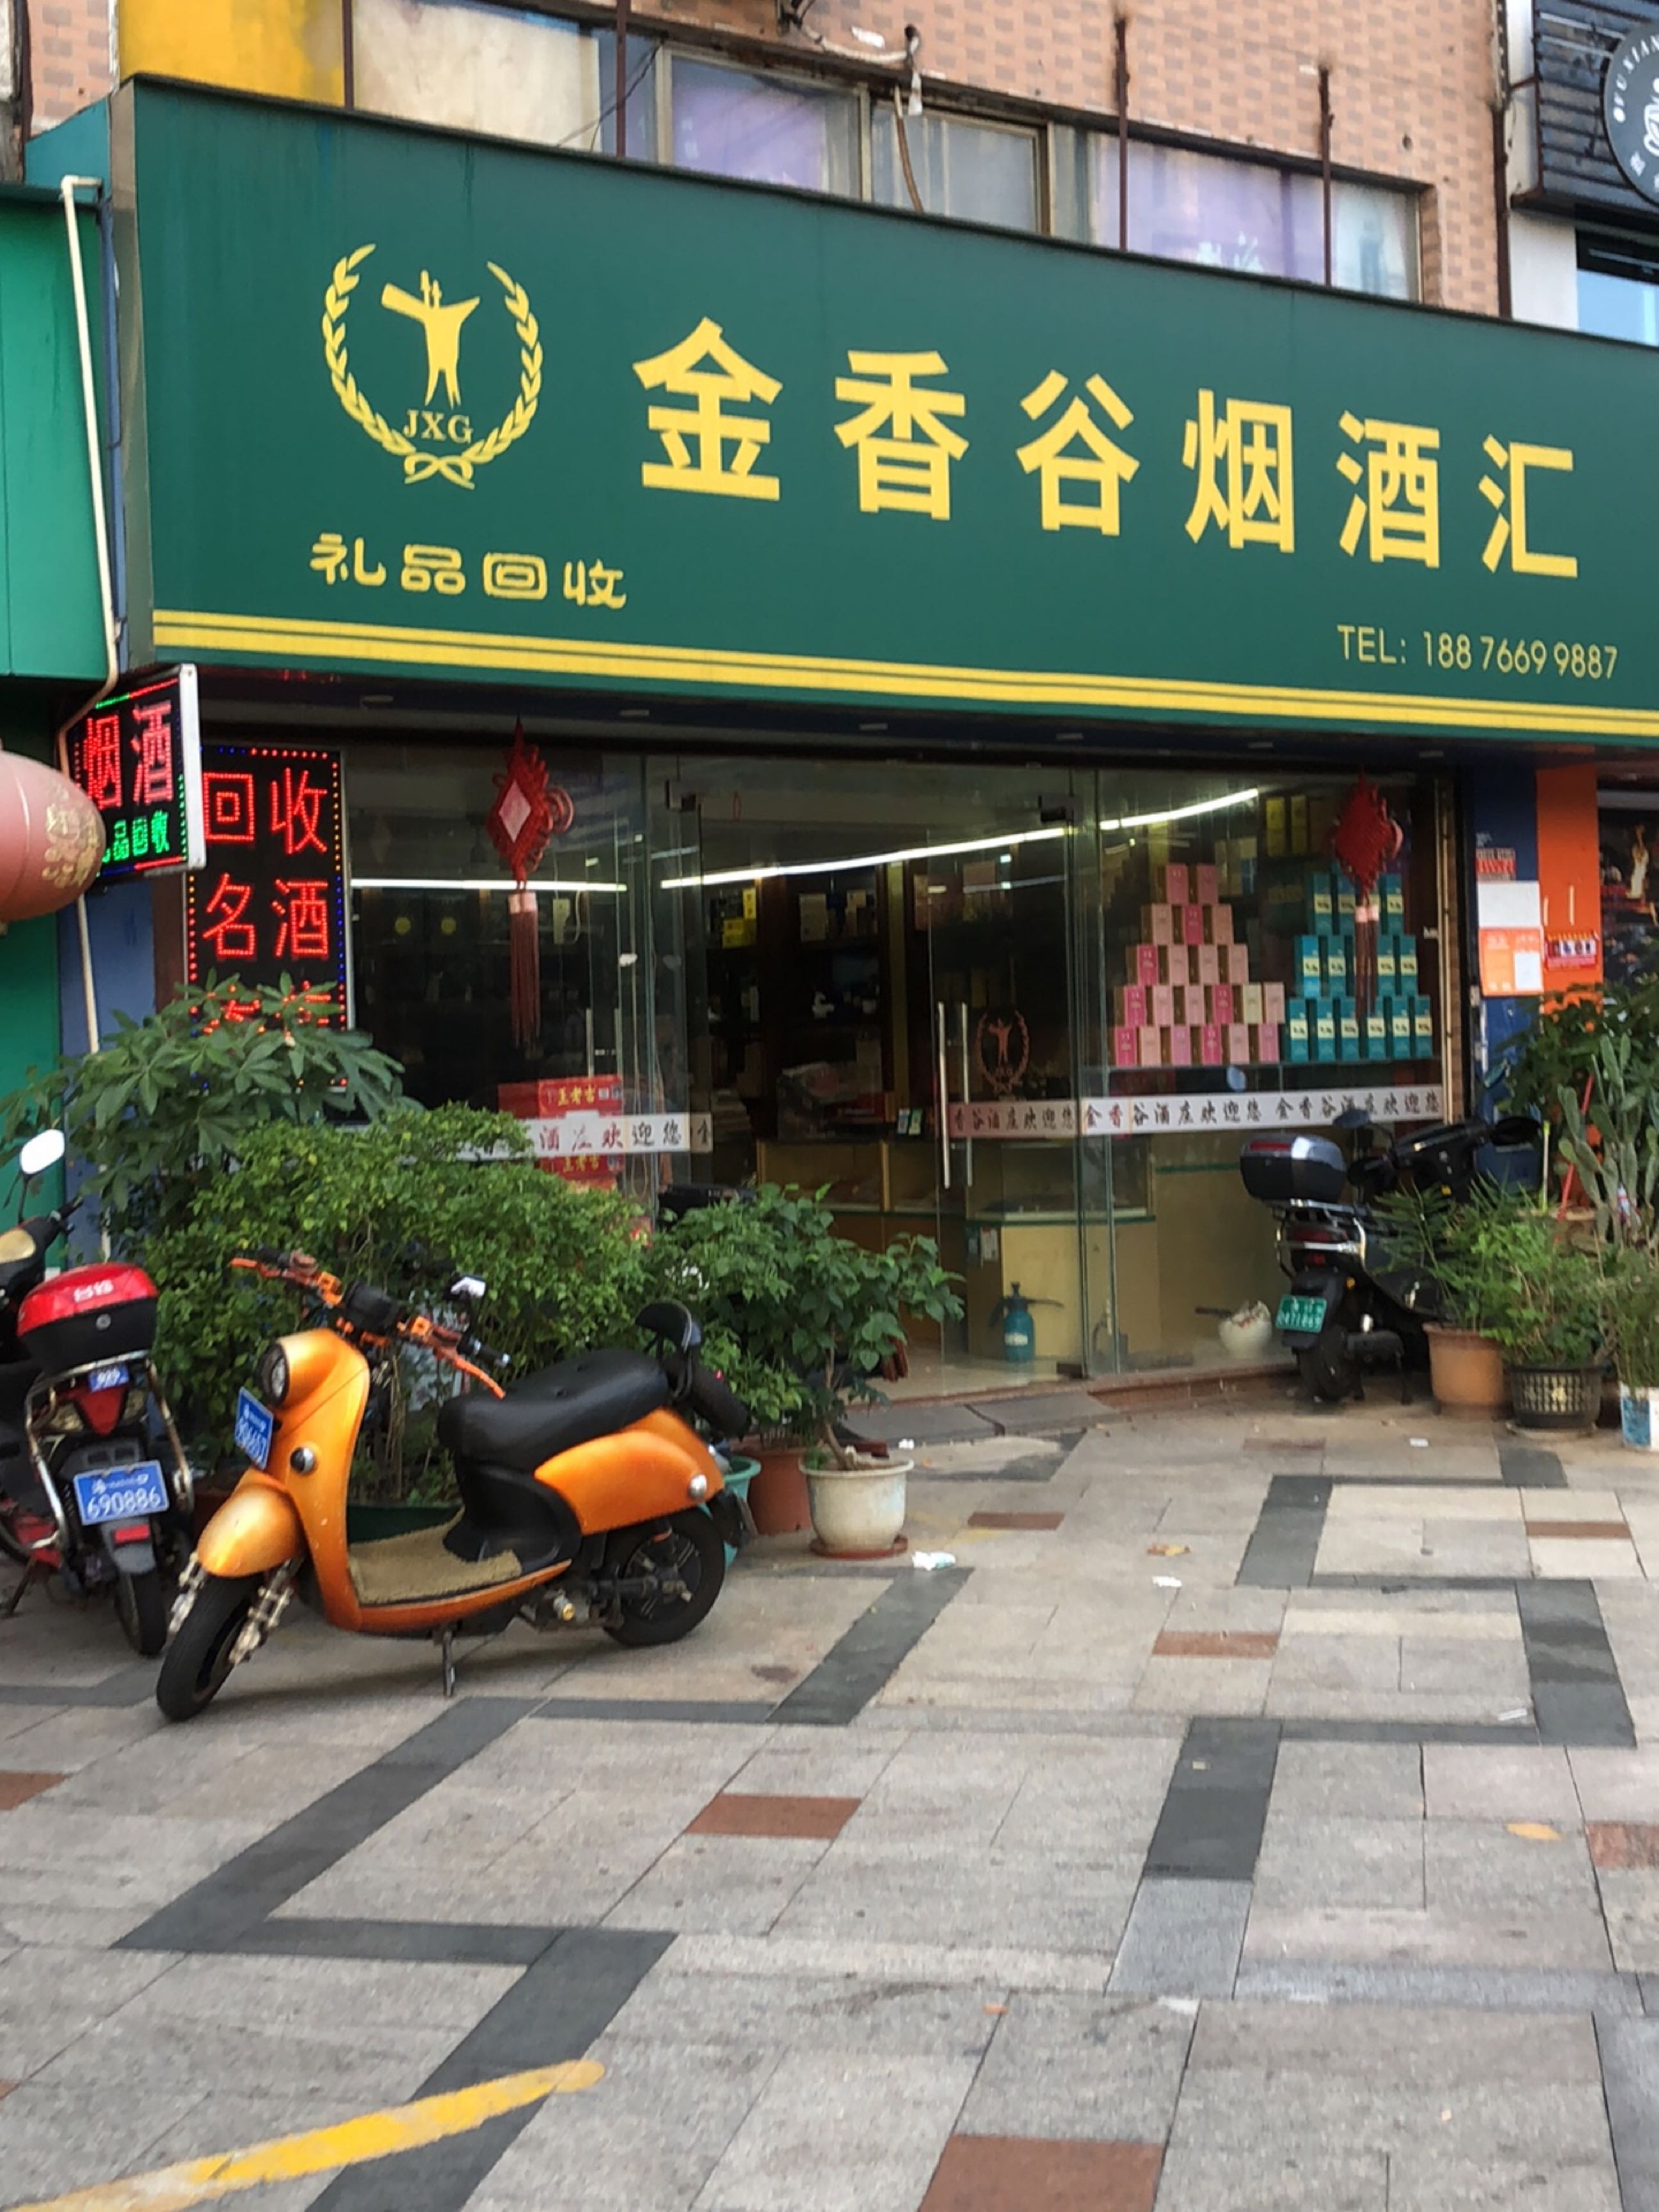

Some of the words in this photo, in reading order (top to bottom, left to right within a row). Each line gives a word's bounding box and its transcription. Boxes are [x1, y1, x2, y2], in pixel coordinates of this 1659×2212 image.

[403, 408, 474, 444] JXG
[632, 317, 1578, 579] 金香谷烟酒汇
[309, 532, 627, 609] 礼品回收
[1337, 624, 1406, 665] TEL:
[83, 701, 173, 810] 烟酒
[203, 767, 328, 854] 回收
[202, 872, 329, 958] 名酒
